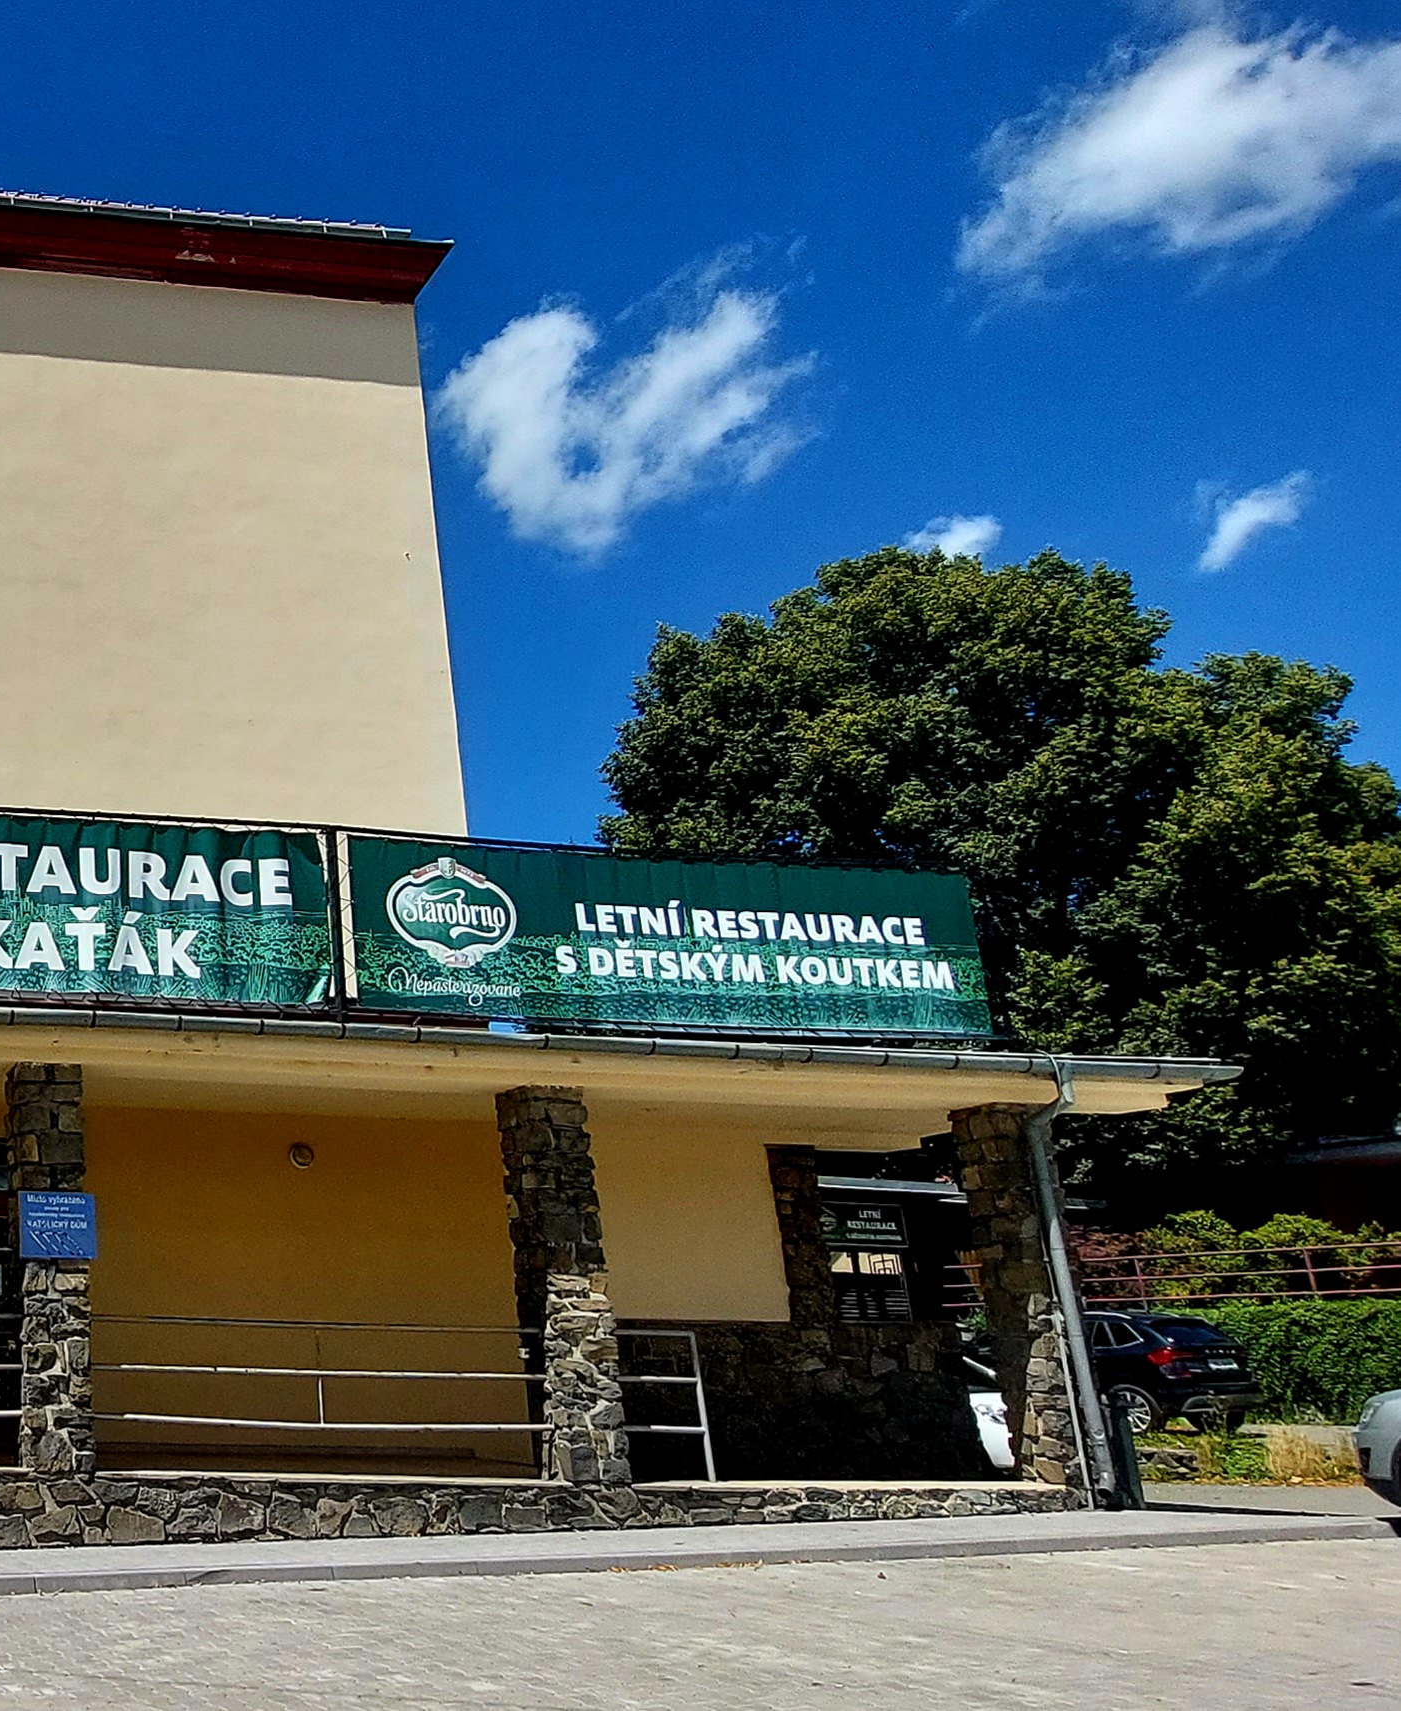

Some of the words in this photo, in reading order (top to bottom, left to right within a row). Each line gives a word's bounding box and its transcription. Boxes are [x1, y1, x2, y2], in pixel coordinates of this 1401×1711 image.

[402, 888, 506, 940] Starobrno
[575, 898, 683, 937] LETNÍ
[694, 907, 926, 947] RESTAURACE
[556, 948, 576, 974] S
[588, 941, 766, 984] DĚTSKÝM
[776, 954, 956, 991] KOUTKEM
